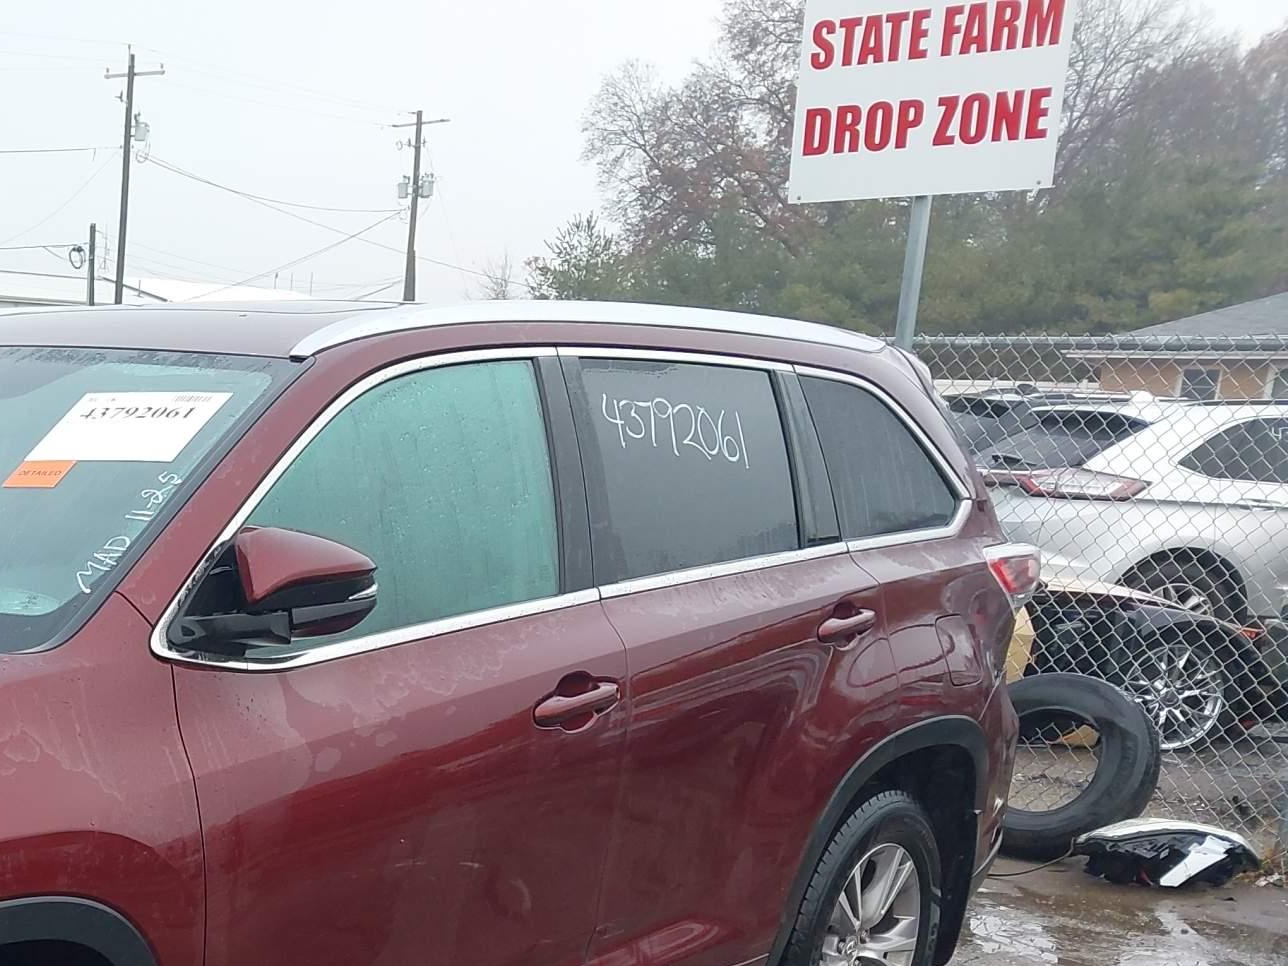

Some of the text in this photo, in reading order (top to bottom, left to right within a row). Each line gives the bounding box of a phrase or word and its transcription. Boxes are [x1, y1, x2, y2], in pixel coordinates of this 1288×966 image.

[810, 0, 1065, 70] STATE FARM
[803, 86, 1053, 157] DROP ZONE
[79, 406, 196, 420] 43792061
[601, 393, 750, 469] 43792061
[17, 469, 63, 477] DETAILED
[76, 535, 131, 594] MAD
